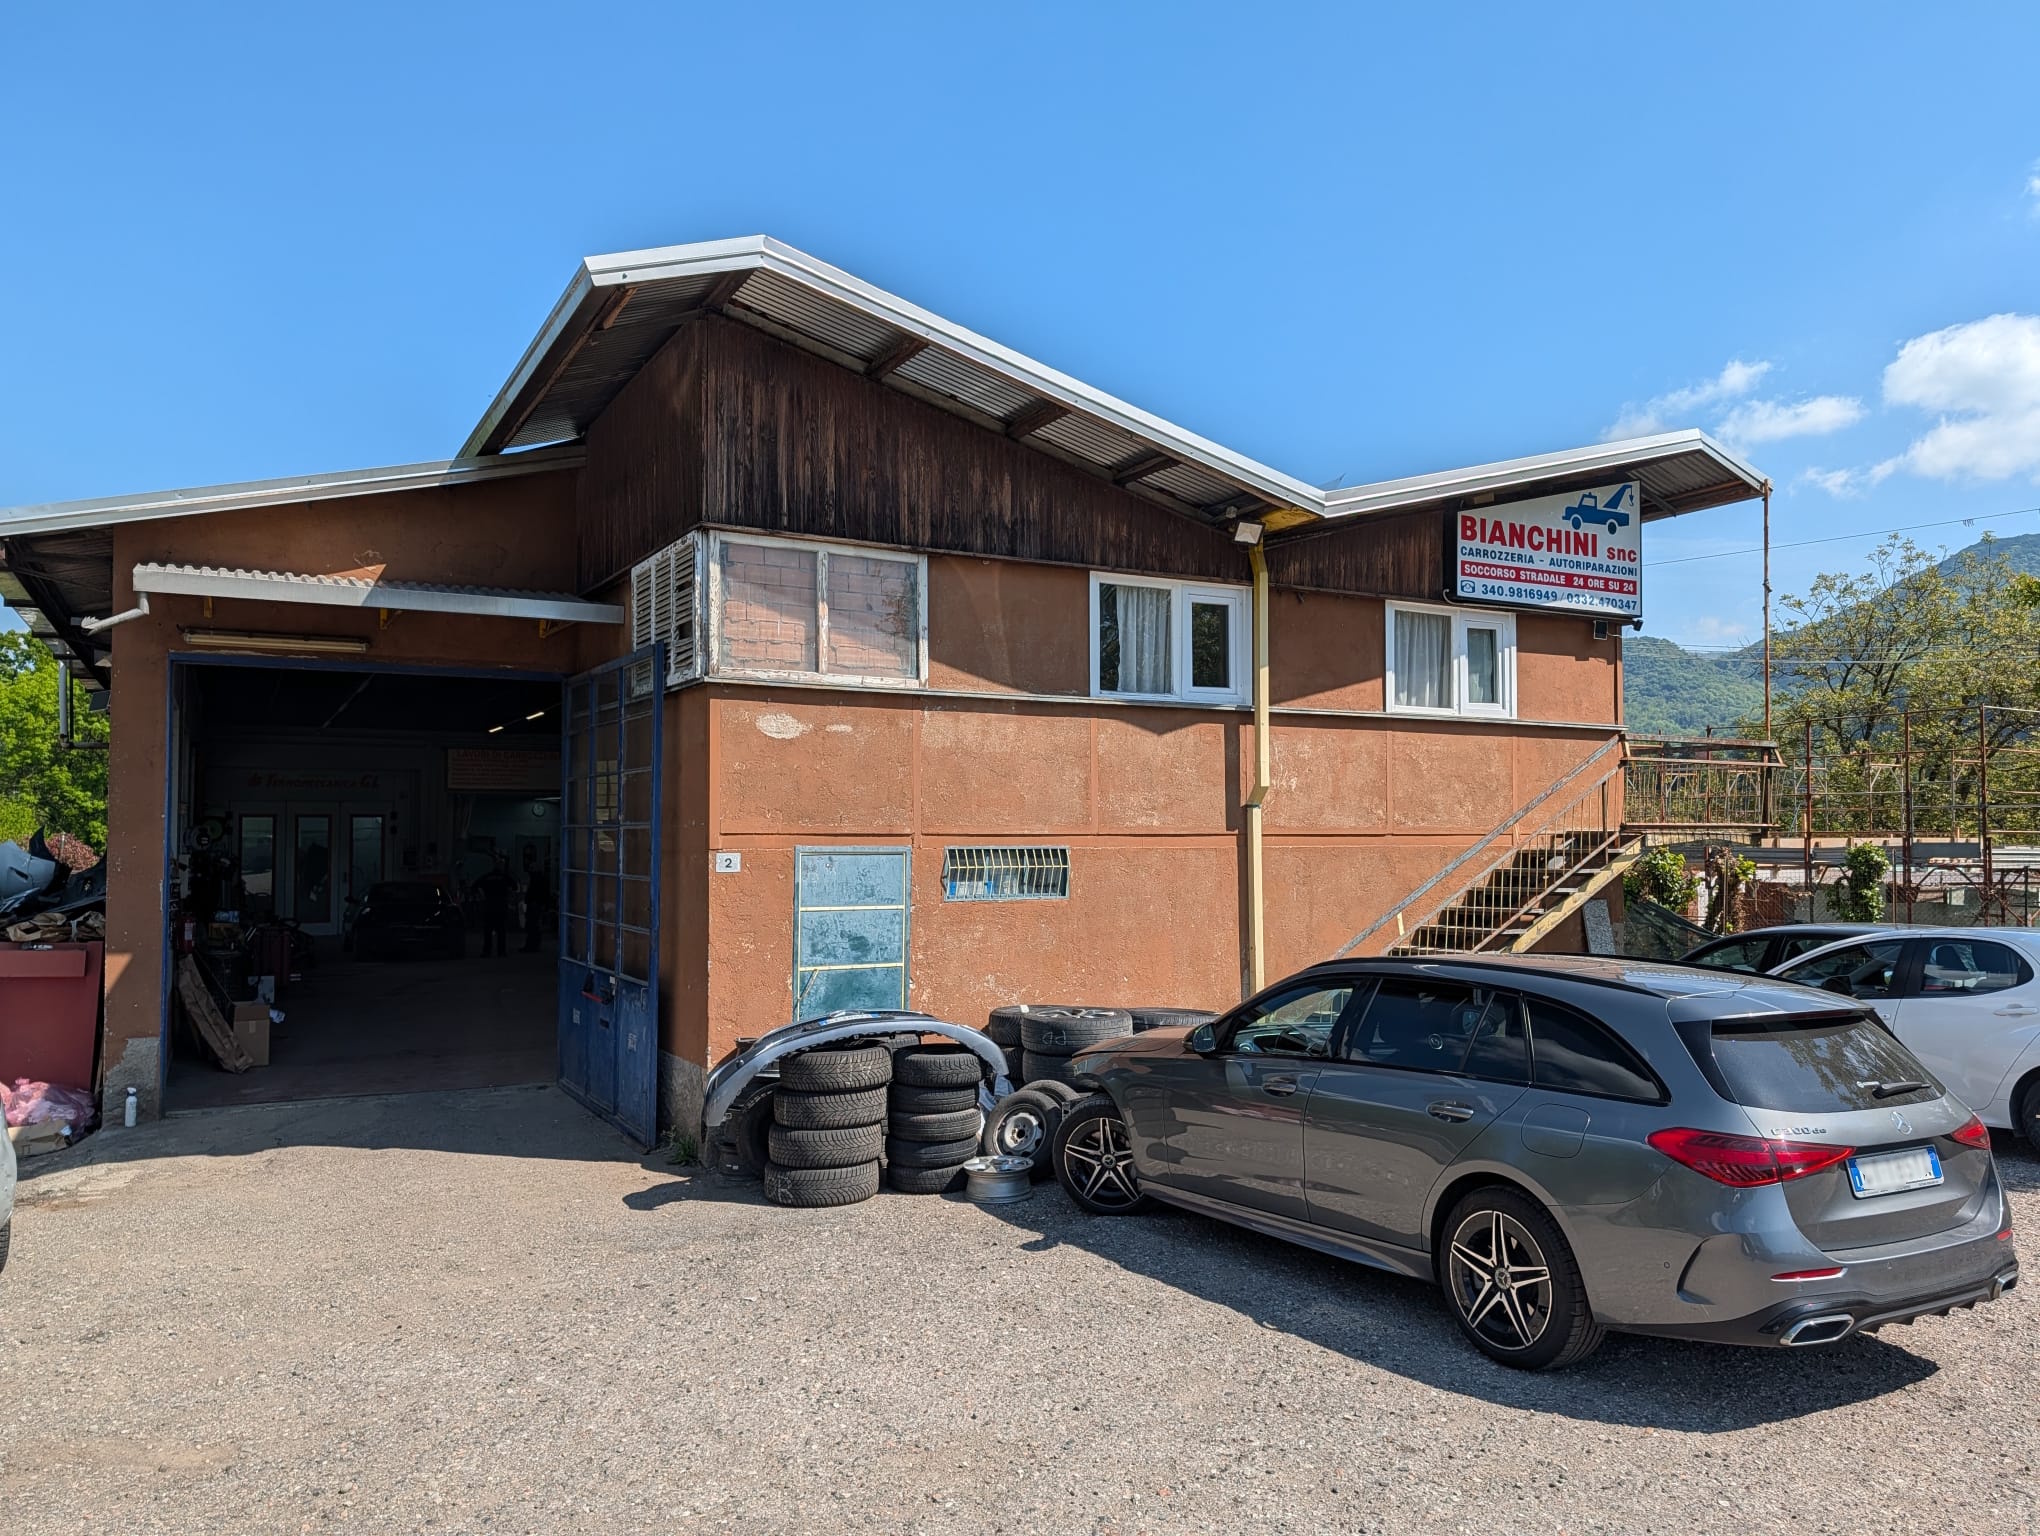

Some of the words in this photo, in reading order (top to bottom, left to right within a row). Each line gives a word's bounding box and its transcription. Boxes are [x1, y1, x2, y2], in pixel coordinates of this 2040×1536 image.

[1461, 515, 1598, 557] BIANCHINI
[1607, 546, 1637, 563] snc
[1460, 546, 1535, 565] CARROZZERIA
[1549, 557, 1637, 577] AUTORIPARAZIONI
[1464, 564, 1516, 579] SOCCORSO
[1520, 571, 1566, 585] STRADALE
[1573, 577, 1583, 586] 24
[1588, 579, 1605, 589] ORE
[1608, 581, 1619, 591] SU
[1623, 582, 1634, 592] 24
[1481, 584, 1558, 601] 340.9816949
[1566, 593, 1637, 611] 0332.470347
[724, 858, 733, 868] 2
